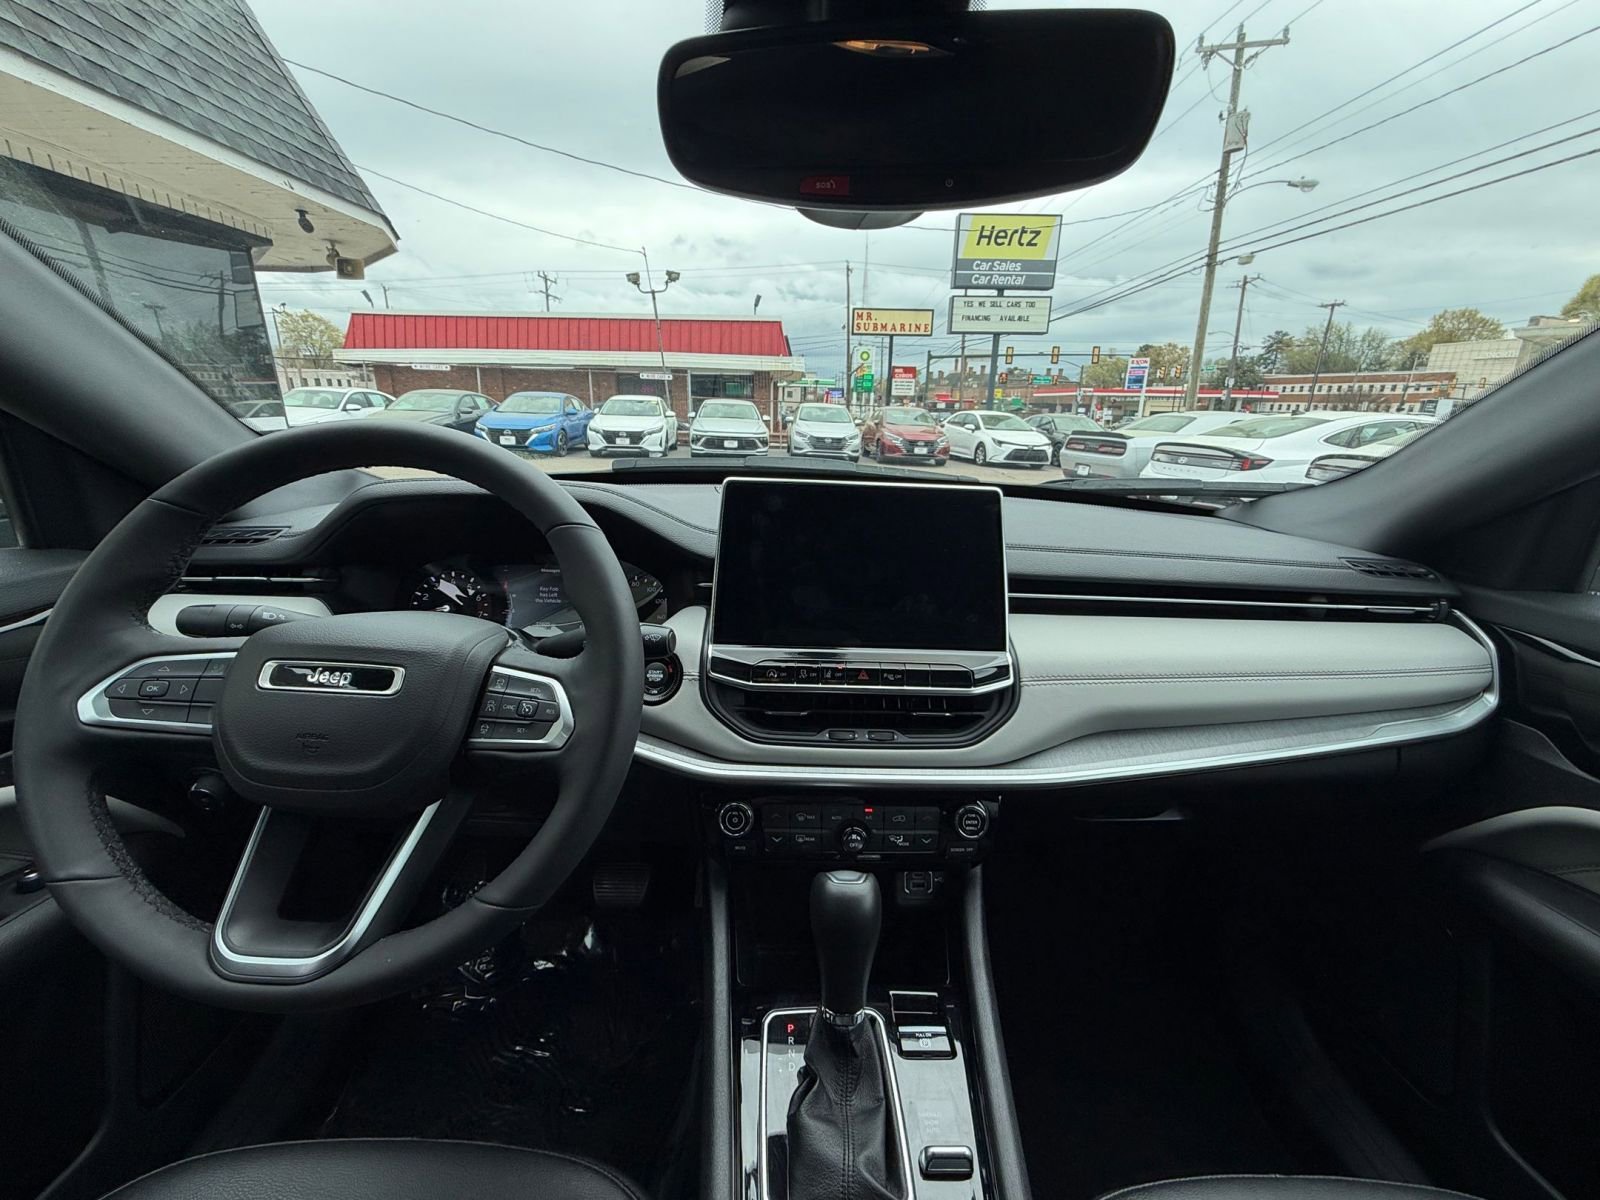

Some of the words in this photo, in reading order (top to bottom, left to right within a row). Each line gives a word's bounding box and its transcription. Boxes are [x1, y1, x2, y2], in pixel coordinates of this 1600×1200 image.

[976, 225, 1041, 247] Hertz
[972, 261, 991, 271] Car
[992, 261, 1022, 271] Sales
[971, 274, 991, 285] Car
[991, 275, 1026, 285] Rental
[856, 311, 878, 321] MR.
[855, 322, 930, 333] SUBMARINE
[307, 667, 352, 686] Jeep
[787, 1023, 795, 1033] P
[788, 1036, 795, 1045] R
[788, 1049, 796, 1057] N
[788, 1062, 796, 1071] D
